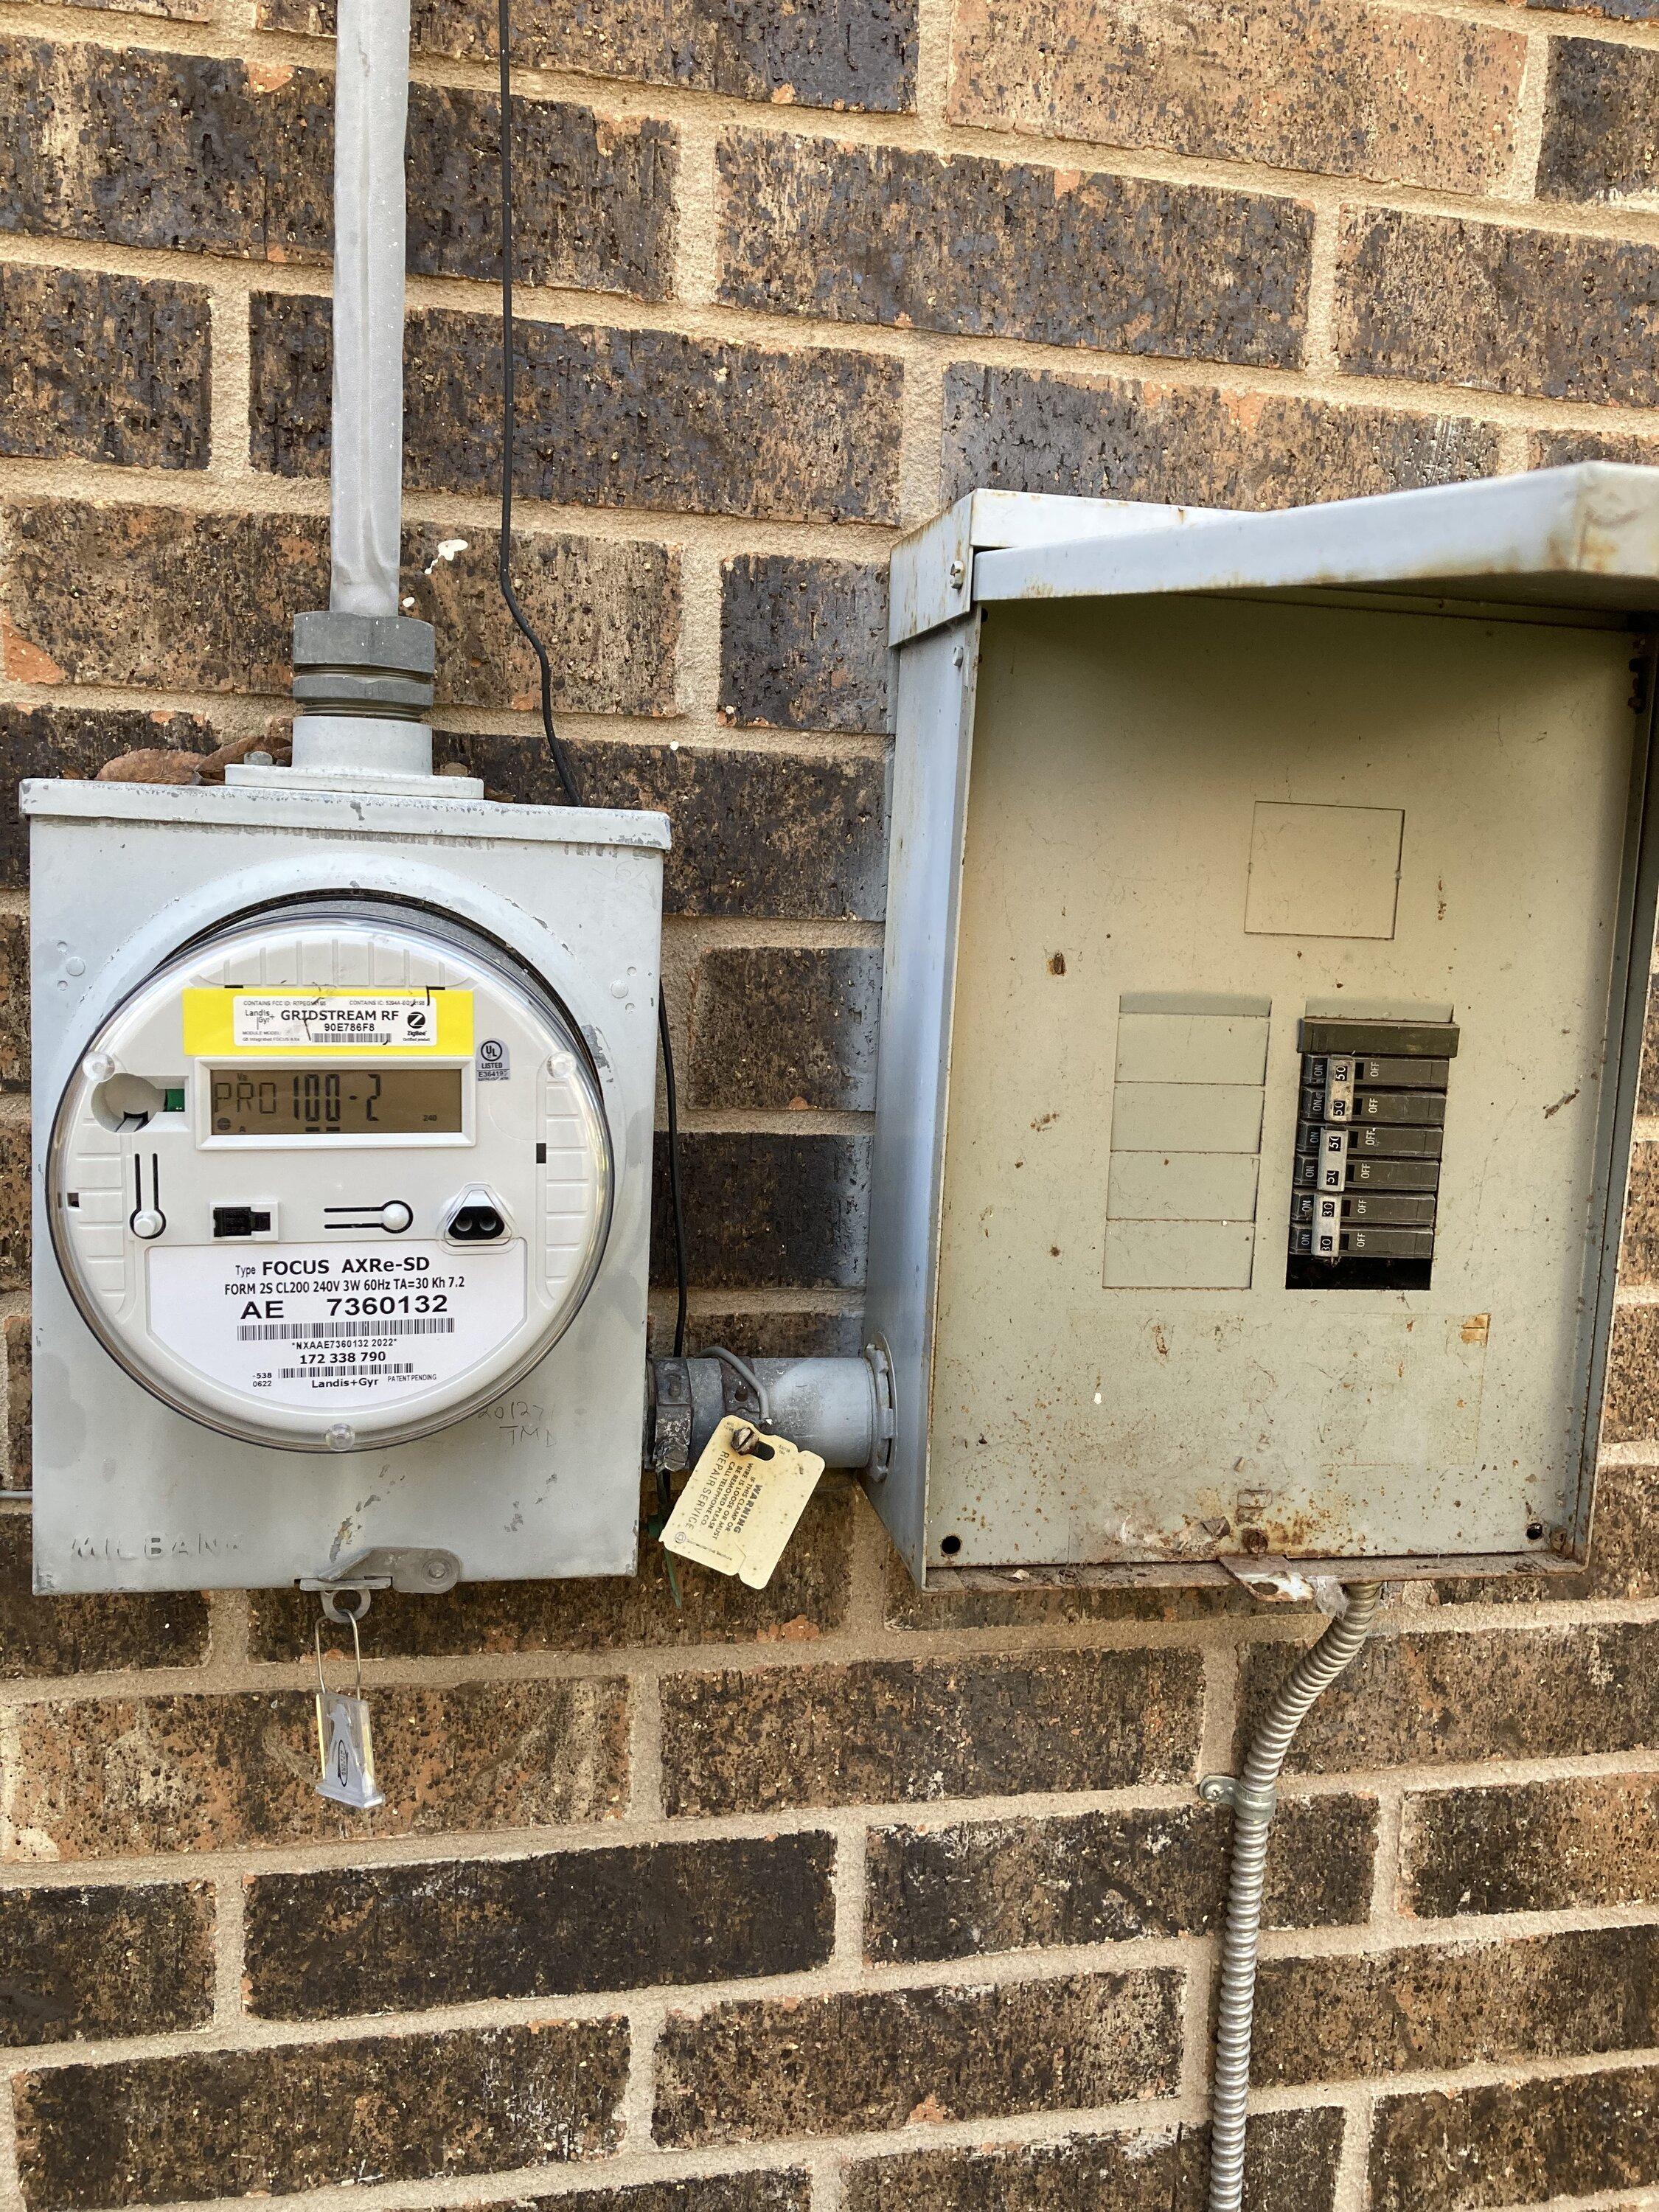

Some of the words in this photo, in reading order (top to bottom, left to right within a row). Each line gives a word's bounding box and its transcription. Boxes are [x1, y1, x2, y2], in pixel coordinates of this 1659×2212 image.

[281, 1009, 377, 1021] GRIDSTREAM
[381, 1009, 400, 1020] RF
[324, 1023, 375, 1032] 90E786F8
[485, 1045, 498, 1057] UL
[1314, 1065, 1324, 1076] ON
[1336, 1066, 1346, 1081] 50
[1370, 1062, 1380, 1077] OFF
[215, 1082, 276, 1114] PRO
[1313, 1099, 1322, 1111] ON
[1368, 1098, 1378, 1113] OFF
[1310, 1131, 1319, 1143] ON
[1366, 1130, 1376, 1146] OFF
[1306, 1166, 1315, 1178] ON
[1361, 1164, 1371, 1179] OFF
[1302, 1200, 1311, 1211] ON
[1357, 1199, 1367, 1214] OFF
[1301, 1234, 1310, 1245] ON
[1357, 1233, 1366, 1248] OFF
[235, 1265, 256, 1278] Type
[262, 1259, 330, 1276] FOCUS
[341, 1256, 430, 1273] AXRe-SD
[225, 1283, 256, 1295] FORM
[260, 1282, 273, 1294] 2S
[276, 1281, 310, 1294] CL200
[313, 1281, 340, 1293] 240V
[343, 1279, 361, 1292] 3W
[364, 1279, 391, 1290] 60Hz
[393, 1277, 428, 1290] TA=30
[432, 1276, 445, 1289] Kh
[448, 1276, 465, 1288] 7.2
[240, 1300, 285, 1320] AE
[327, 1294, 448, 1317] 7360132
[299, 1354, 326, 1365] 172
[330, 1352, 356, 1363] 338
[361, 1351, 386, 1362] 790
[312, 1377, 379, 1389] Landis+Gyr
[387, 1374, 410, 1382] PATENT
[411, 1374, 437, 1382] PENDING
[706, 1450, 730, 1486] REPAIR
[724, 1461, 735, 1477] CALL
[735, 1465, 742, 1475] BE
[742, 1462, 754, 1478] WIRE
[706, 1478, 728, 1514] TELEPHONE
[720, 1475, 739, 1506] REMOVED
[727, 1487, 742, 1509] LOOSE
[742, 1484, 753, 1498] THIS
[685, 1487, 712, 1531] SERVICE
[722, 1510, 729, 1520] OR
[731, 1498, 745, 1520] CLAMP
[733, 1484, 762, 1534] WARNING
[709, 1506, 723, 1529] PLEASE
[712, 1521, 724, 1540] MUST
[725, 1521, 733, 1531] OR
